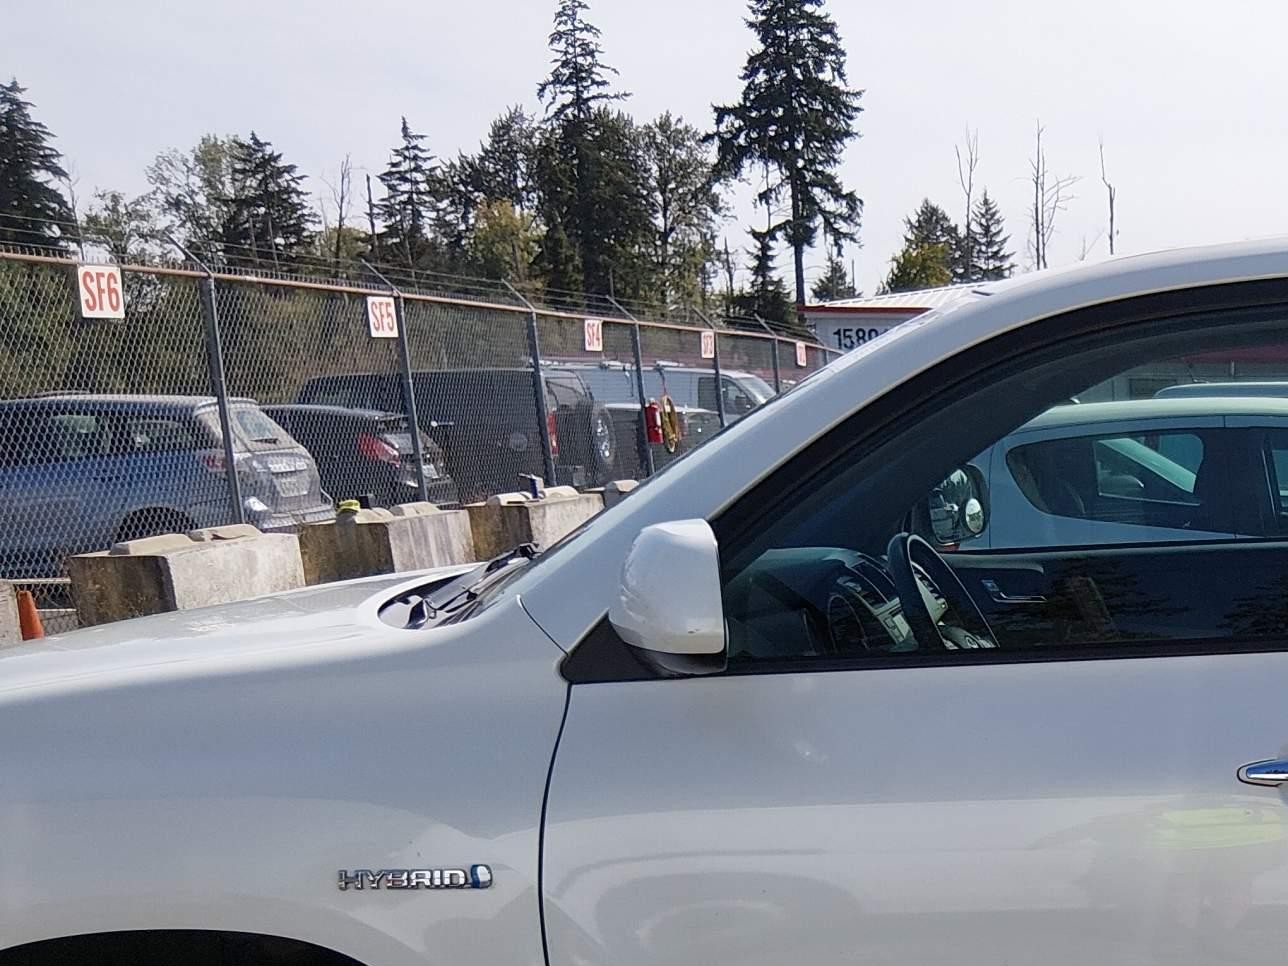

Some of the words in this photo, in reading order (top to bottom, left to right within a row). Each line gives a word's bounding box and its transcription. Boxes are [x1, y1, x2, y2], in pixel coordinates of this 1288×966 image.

[82, 271, 120, 312] SF6
[370, 301, 395, 332] SF5
[338, 869, 468, 890] HYBRID
